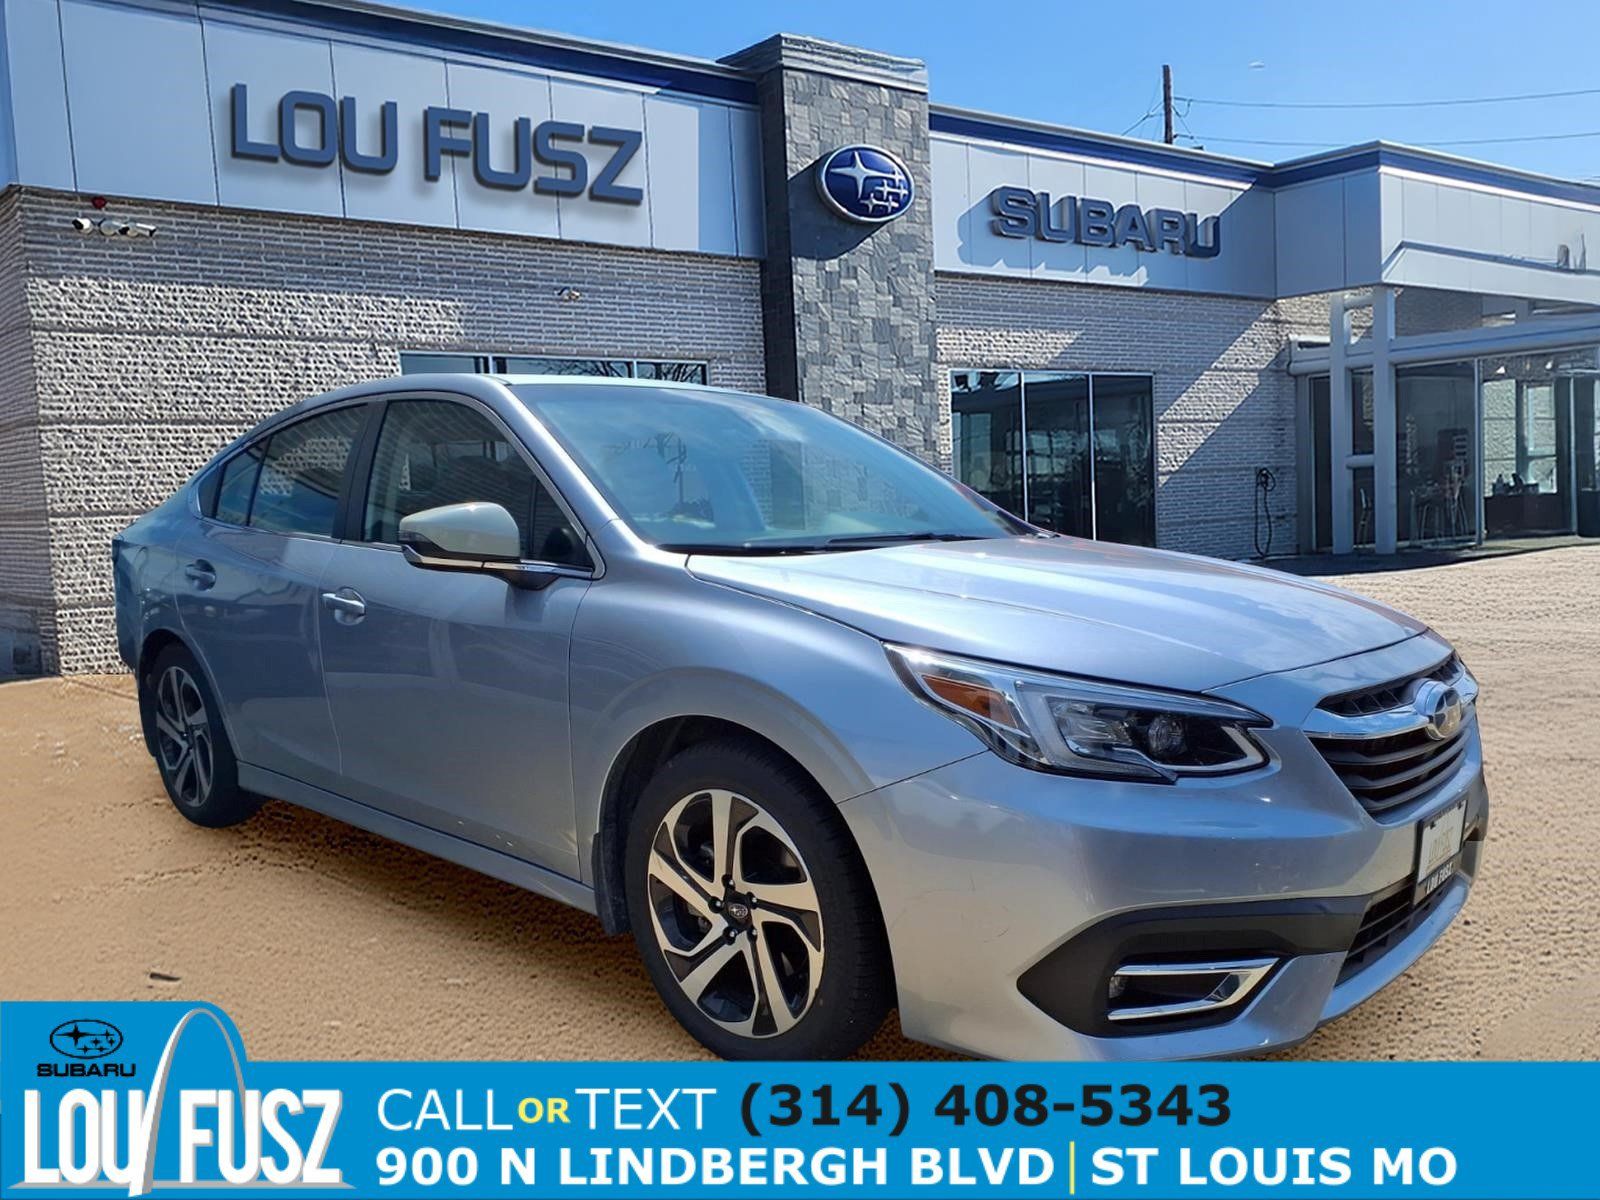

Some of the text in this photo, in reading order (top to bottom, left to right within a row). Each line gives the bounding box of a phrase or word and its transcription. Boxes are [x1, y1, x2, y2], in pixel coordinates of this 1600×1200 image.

[231, 83, 644, 206] LOU FUSZ
[990, 184, 1221, 259] SUBARU
